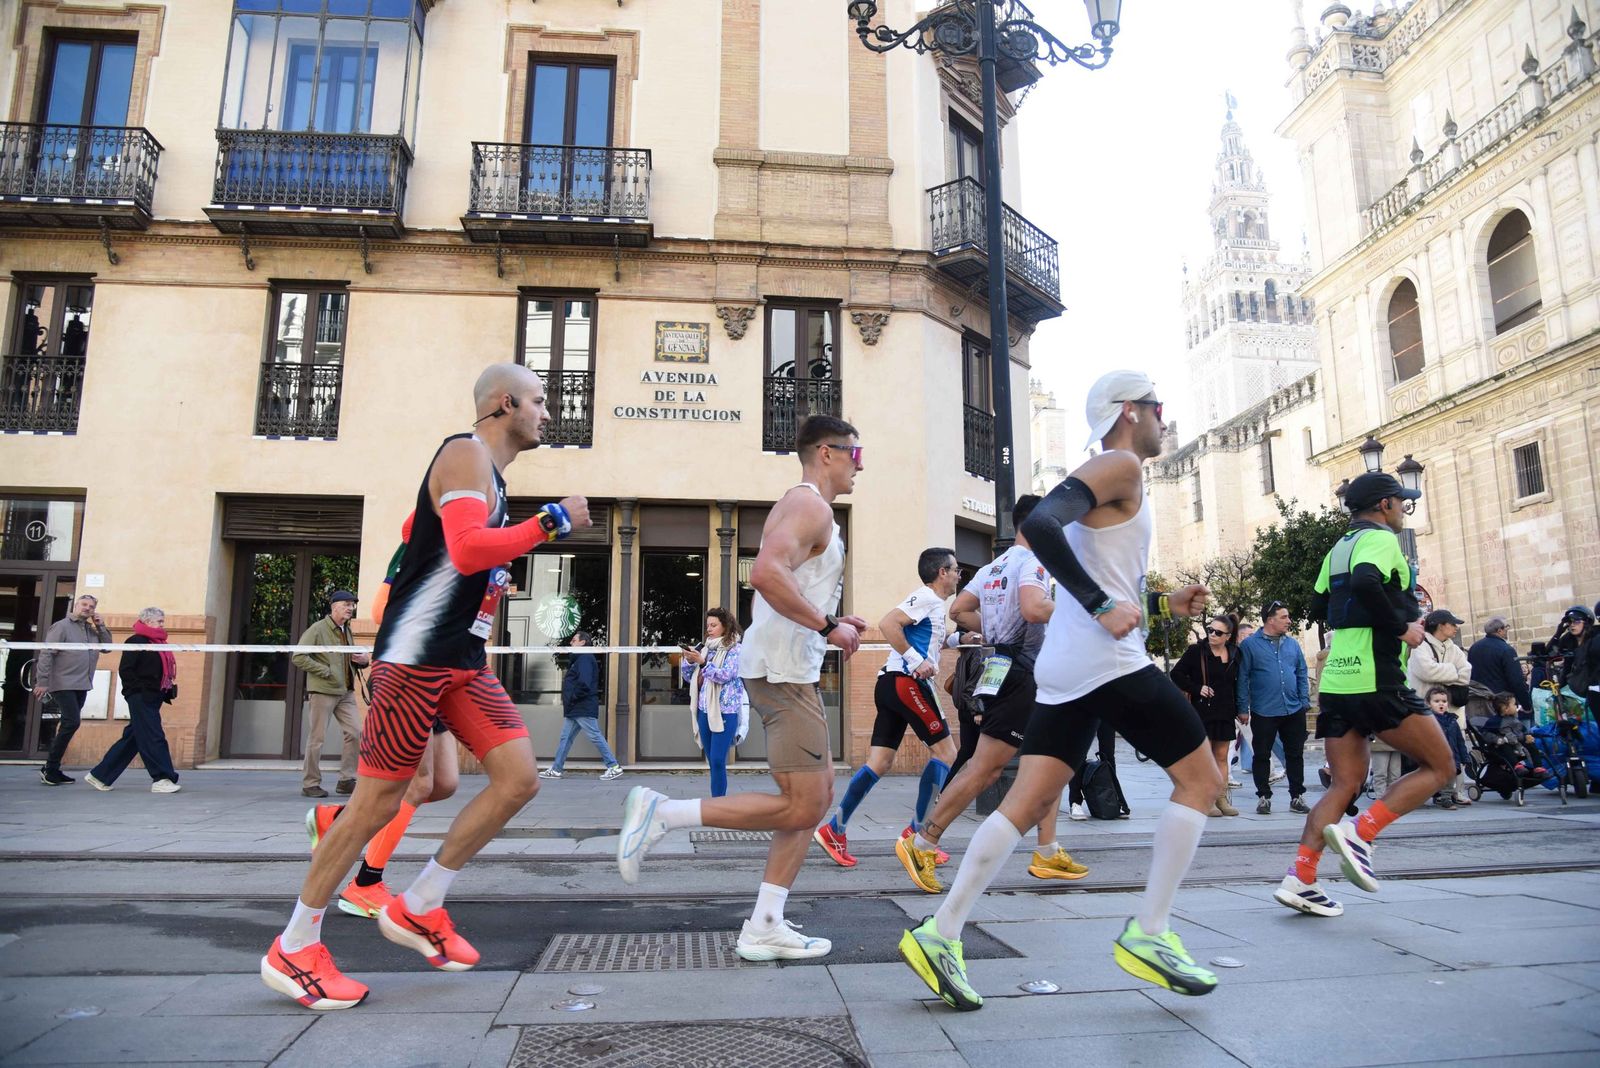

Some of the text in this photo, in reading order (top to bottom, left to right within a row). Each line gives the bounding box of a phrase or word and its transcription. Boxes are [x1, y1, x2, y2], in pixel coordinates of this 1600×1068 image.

[641, 371, 717, 384] AVENIDA
[654, 390, 705, 402] DE LA
[613, 406, 741, 421] CONSTITUCION
[29, 525, 42, 538] 11
